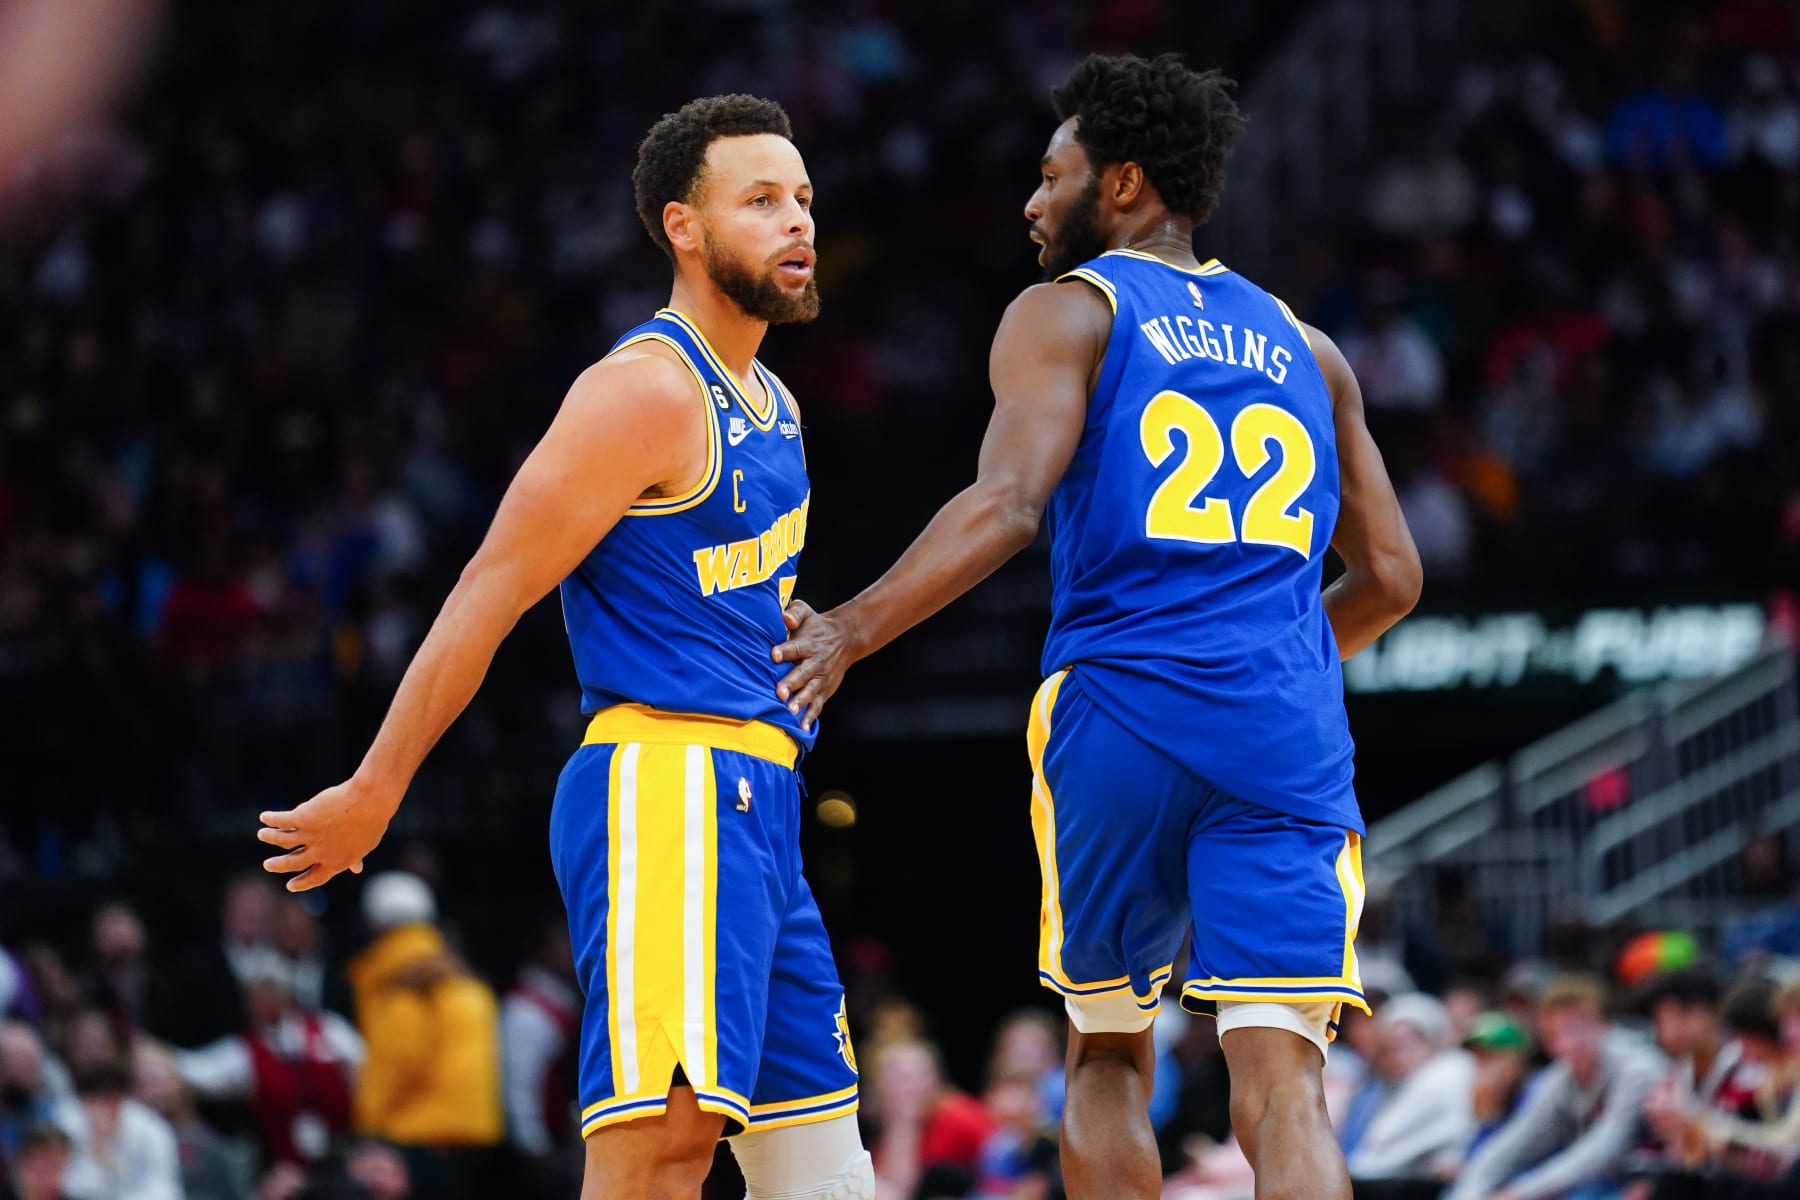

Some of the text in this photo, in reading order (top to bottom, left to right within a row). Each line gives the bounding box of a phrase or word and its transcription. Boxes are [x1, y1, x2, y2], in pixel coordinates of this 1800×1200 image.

[1140, 315, 1292, 384] WIGGINS
[710, 385, 729, 409] 6
[732, 469, 747, 513] C
[1140, 389, 1316, 561] 22
[693, 487, 811, 597] WARRIOR
